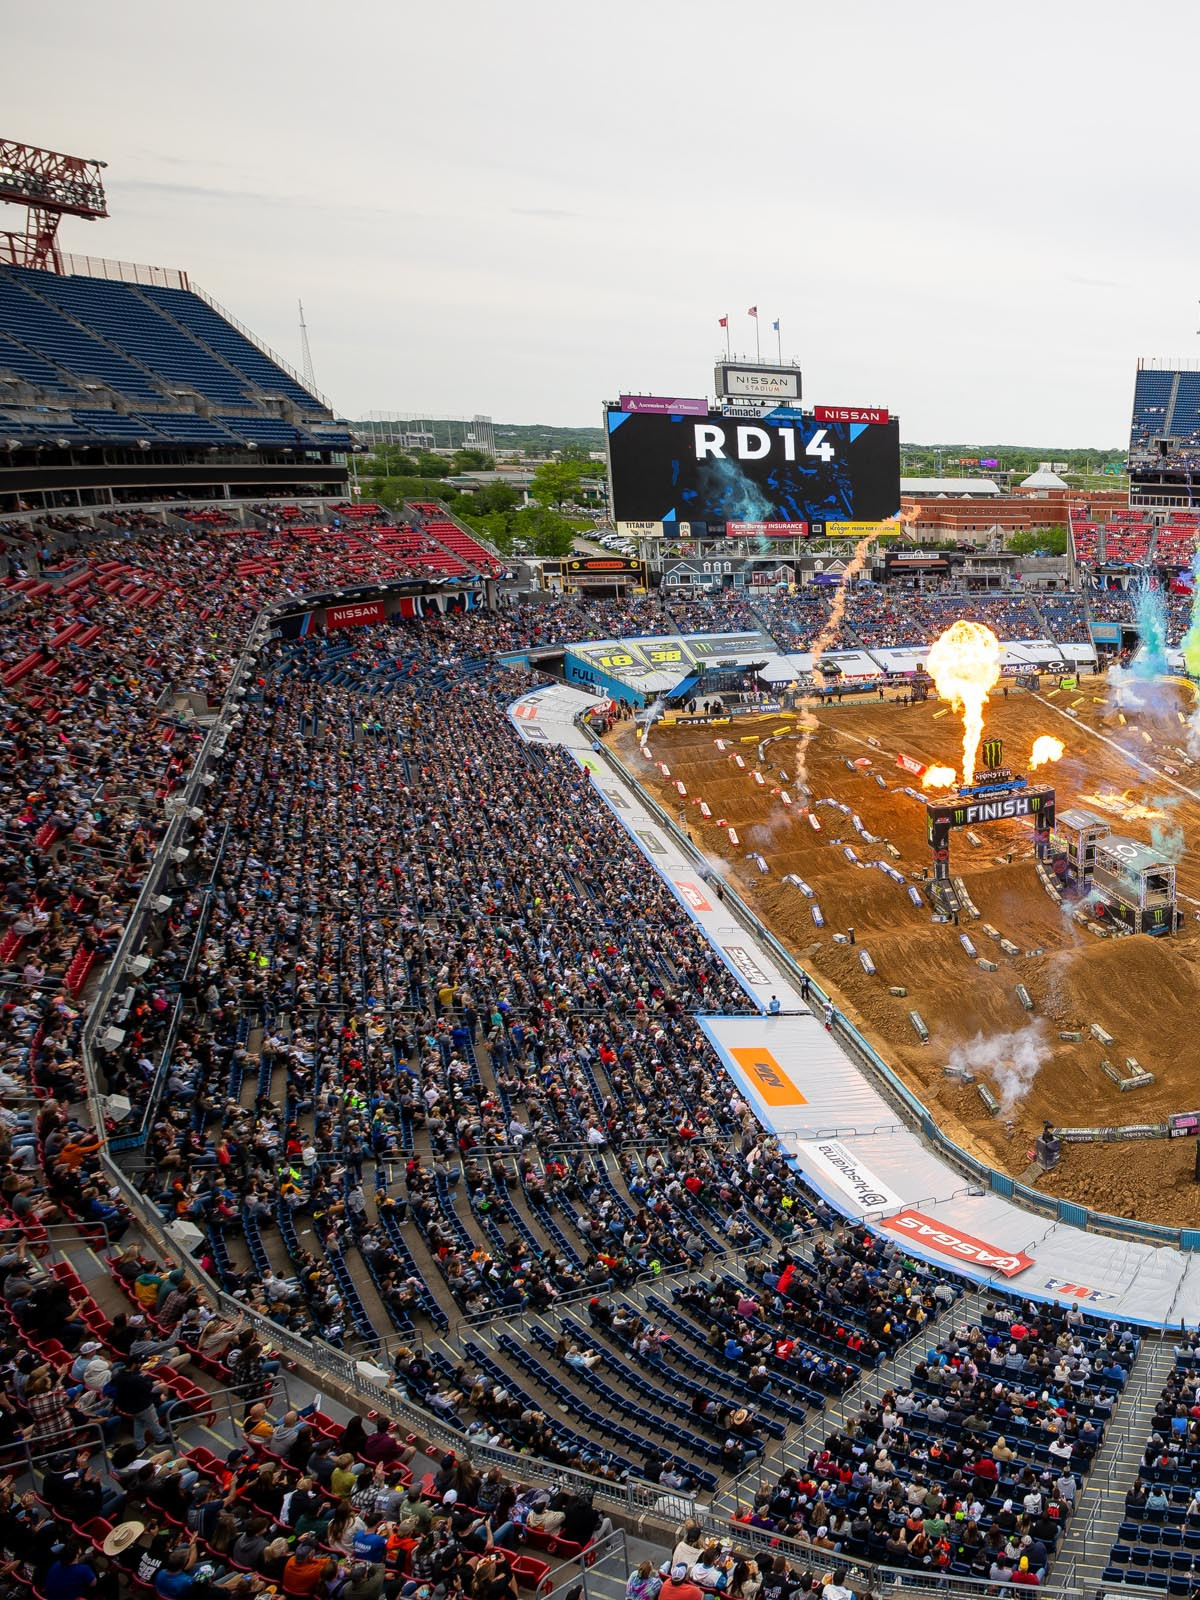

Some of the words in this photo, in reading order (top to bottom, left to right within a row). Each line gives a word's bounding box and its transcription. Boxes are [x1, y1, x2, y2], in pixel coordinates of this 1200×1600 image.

[736, 375, 788, 386] NISSAN
[745, 384, 780, 392] STADIUM
[724, 406, 761, 417] Pinnacle
[825, 410, 880, 421] NISSAN
[694, 424, 834, 462] RD14
[830, 523, 849, 534] Kroger
[334, 606, 378, 620] NISSAN
[599, 655, 633, 667] 18
[651, 650, 681, 662] 38
[1003, 664, 1037, 673] FALKEN
[572, 668, 595, 682] FULL
[975, 770, 1012, 780] MONSTER
[960, 779, 1027, 796] SUPERCROSS
[979, 790, 1009, 798] Championship
[967, 798, 1028, 823] FINISH
[754, 1063, 784, 1088] KTM
[819, 1146, 874, 1193] Husqvarna
[896, 1218, 1020, 1270] GASGAS
